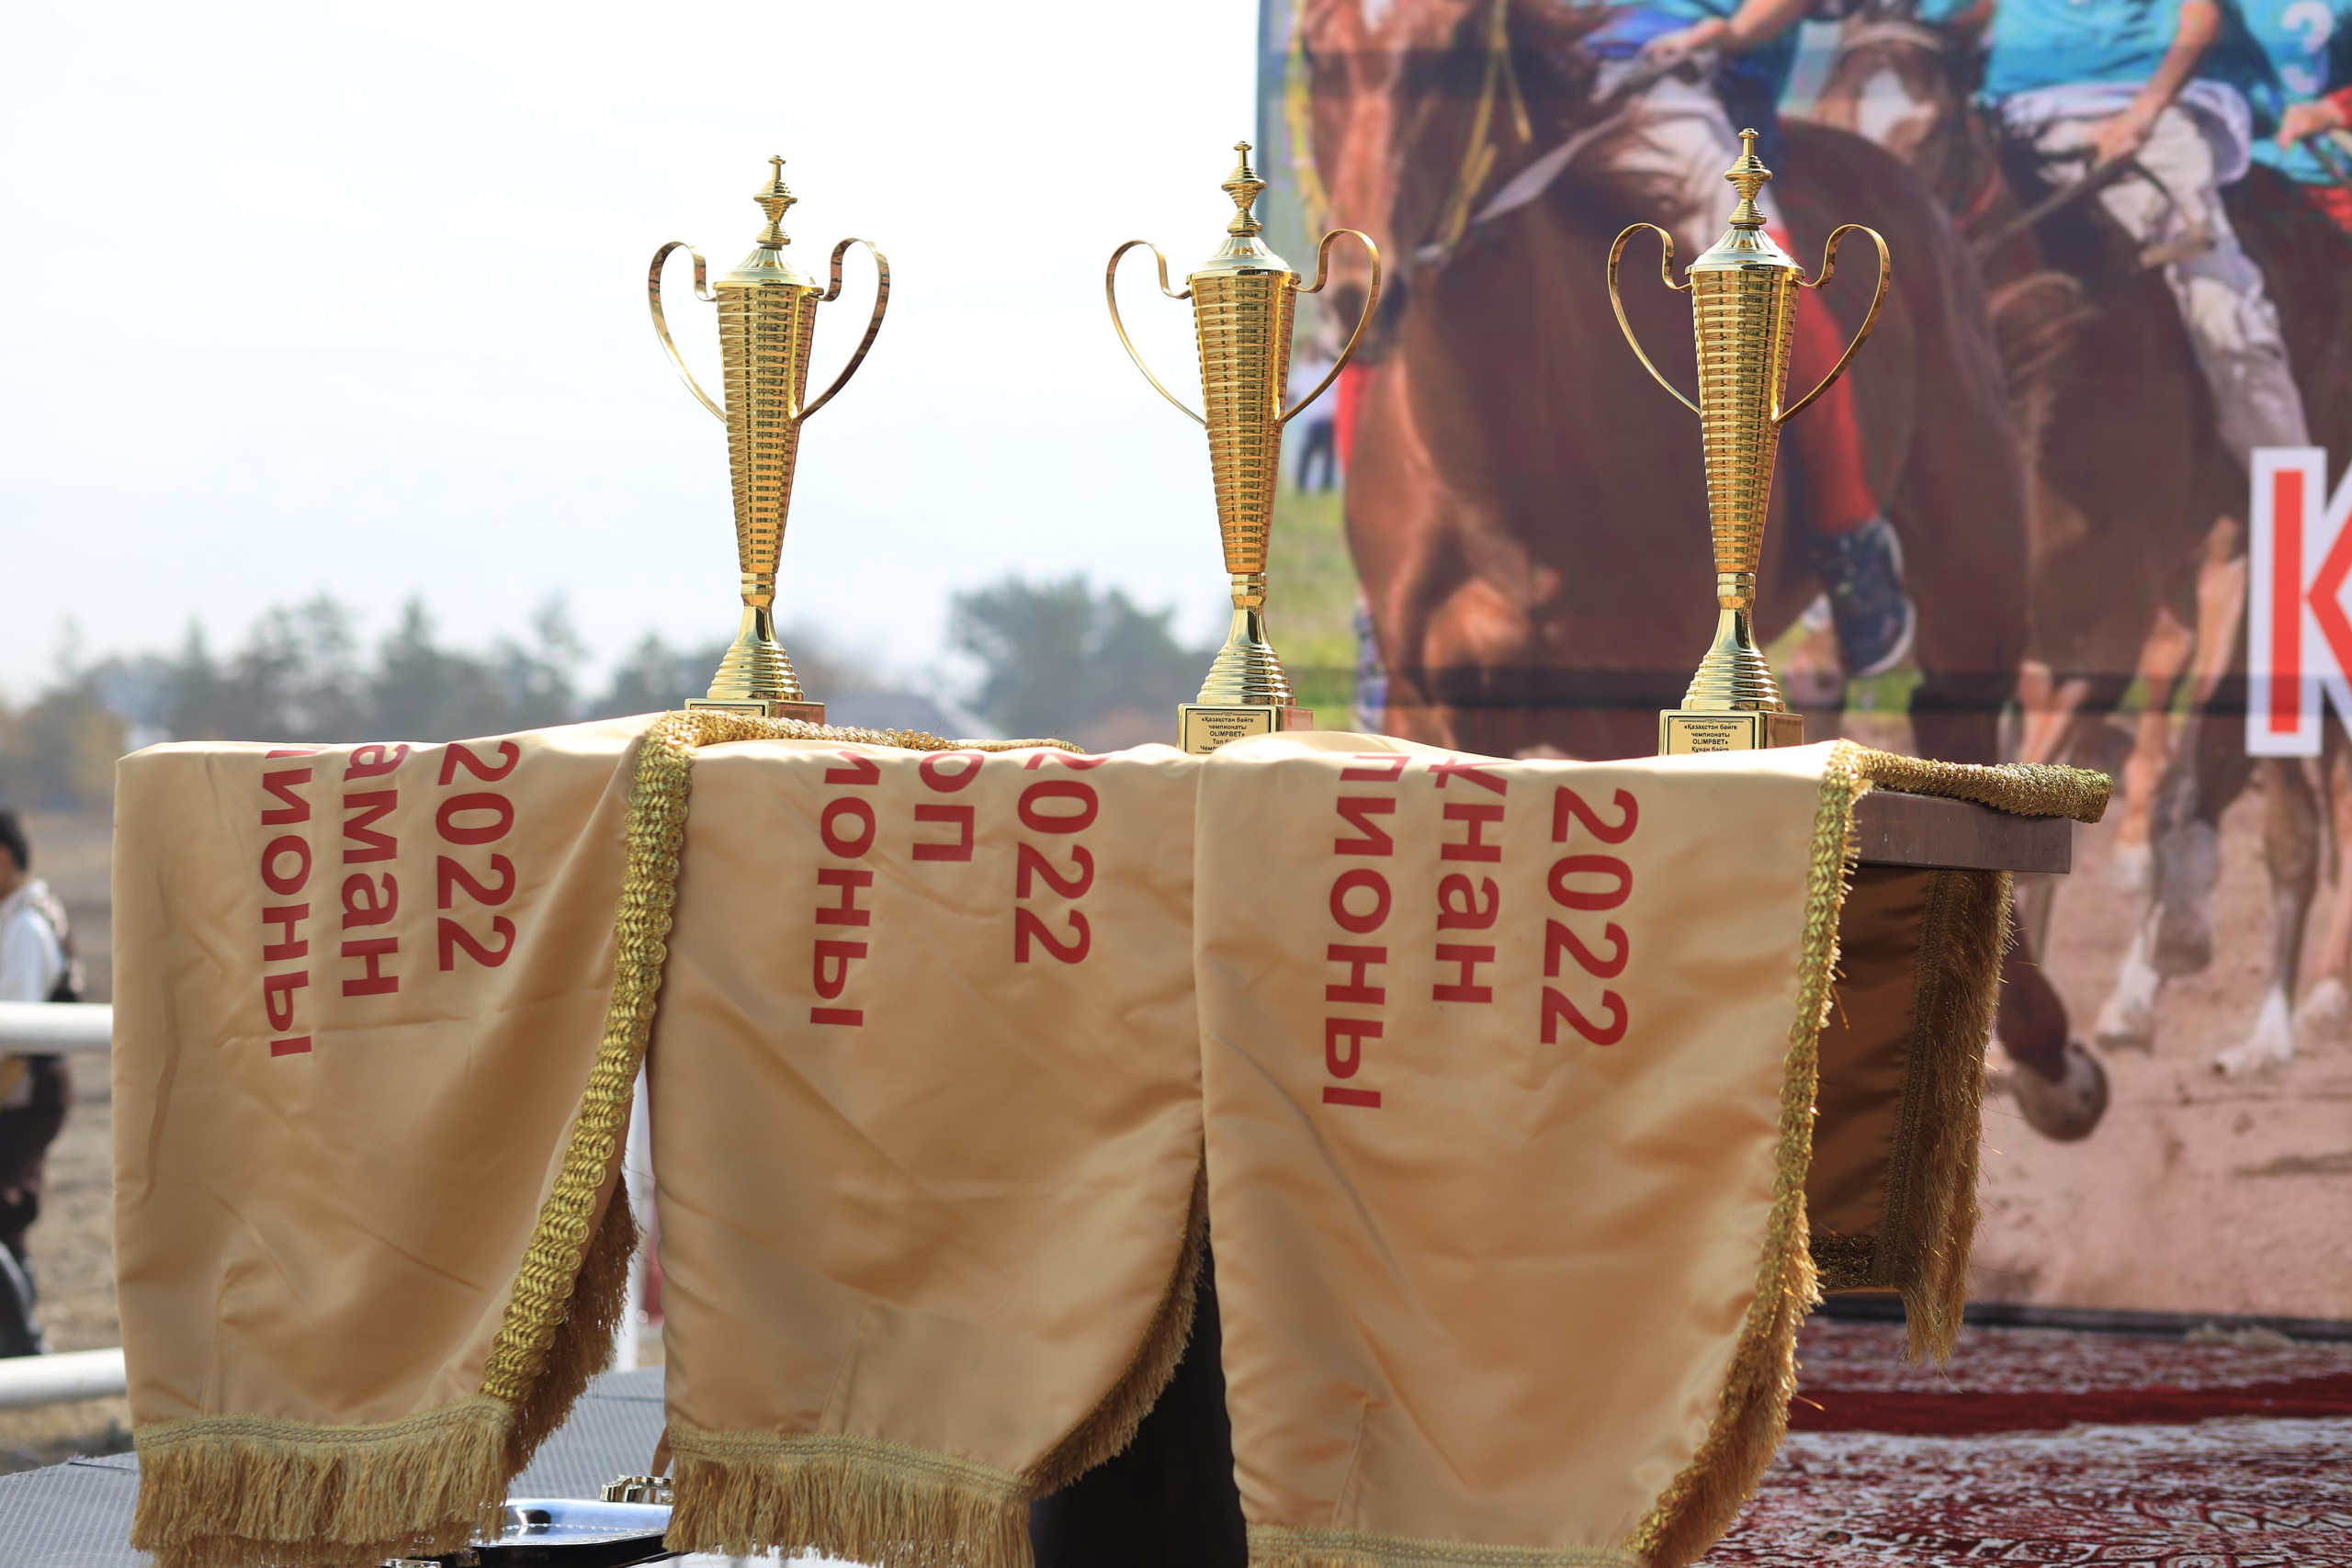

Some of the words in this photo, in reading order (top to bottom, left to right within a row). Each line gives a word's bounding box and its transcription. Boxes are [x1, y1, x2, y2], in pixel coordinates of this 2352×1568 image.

[2281, 1, 2335, 94] 3
[341, 743, 410, 998] аман
[435, 740, 520, 972] 2022
[1322, 754, 1412, 1109] пионы
[1540, 784, 1639, 1046] 2022
